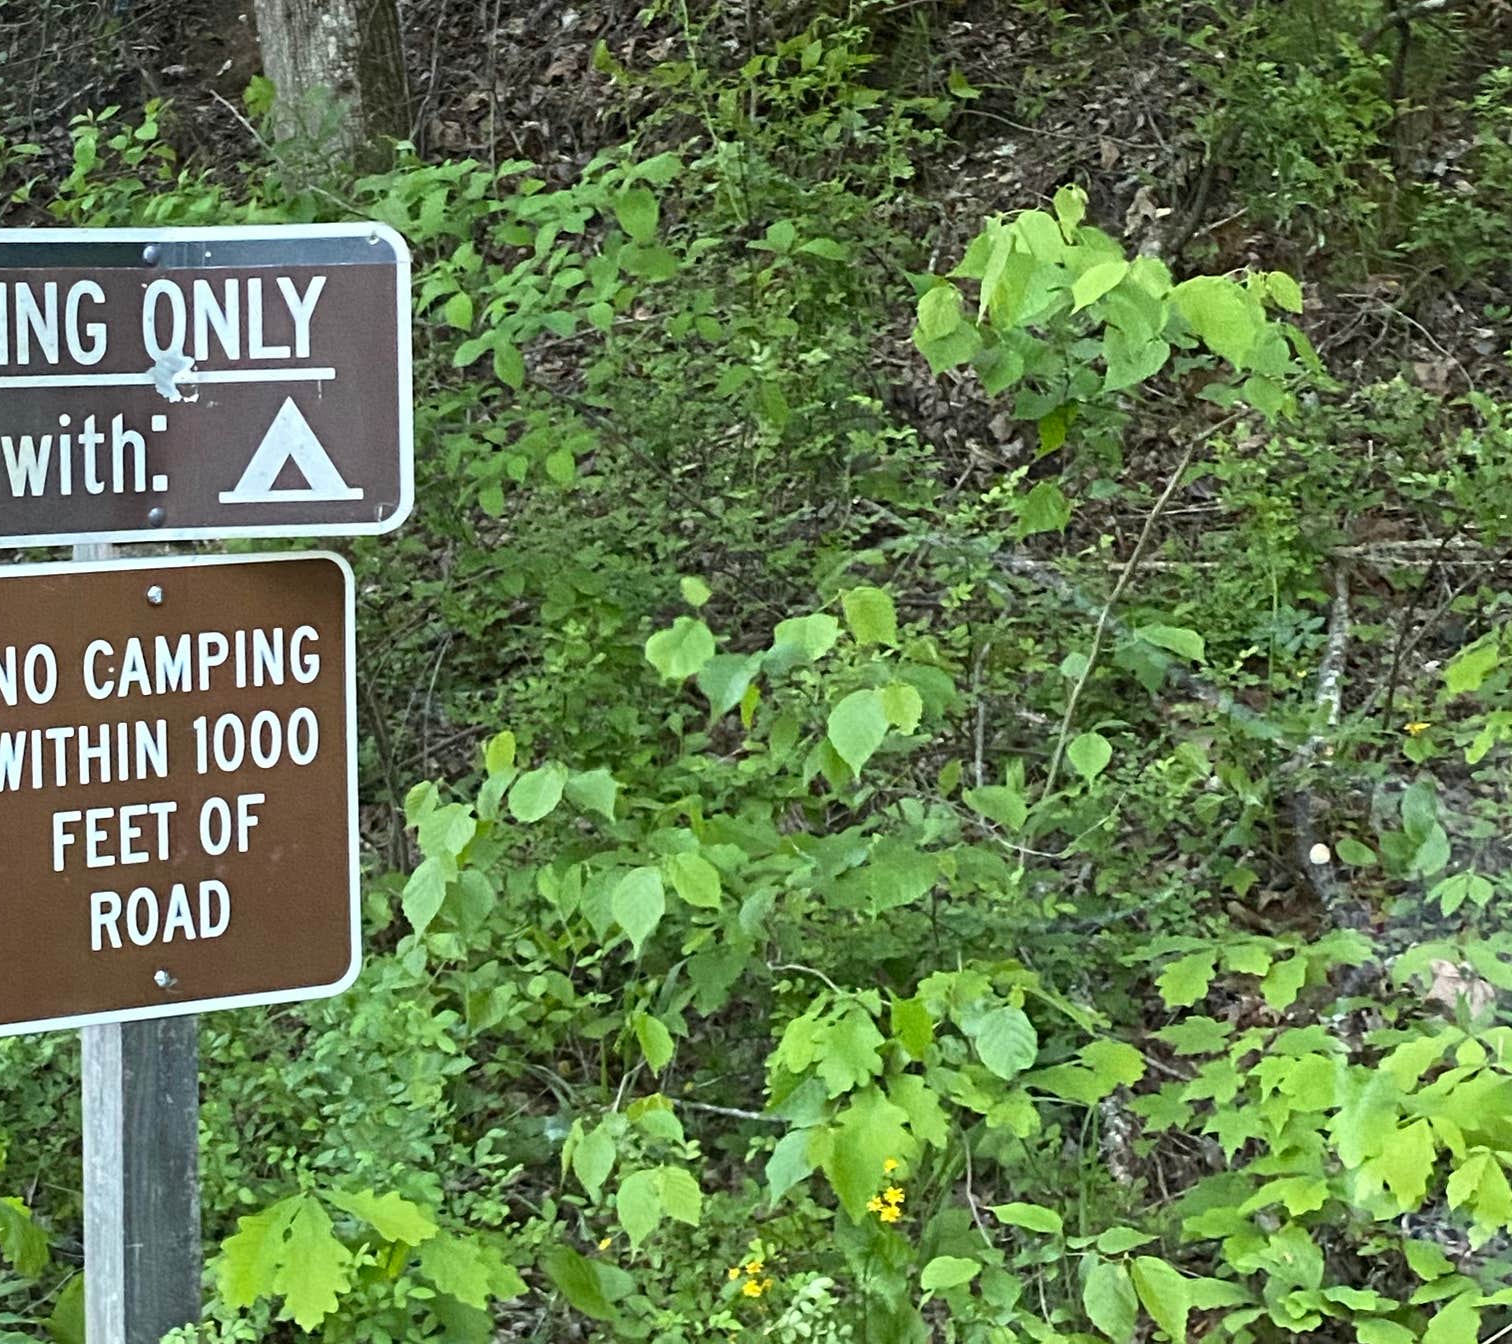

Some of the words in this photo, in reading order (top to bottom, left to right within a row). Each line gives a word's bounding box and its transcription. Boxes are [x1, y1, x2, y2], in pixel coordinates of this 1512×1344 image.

[141, 276, 326, 363] ONLY
[0, 413, 168, 497] with:
[84, 625, 320, 700] CAMPING
[193, 707, 319, 774] 1000
[52, 801, 177, 872] FEET
[199, 793, 265, 855] OF
[90, 879, 231, 951] ROAD
